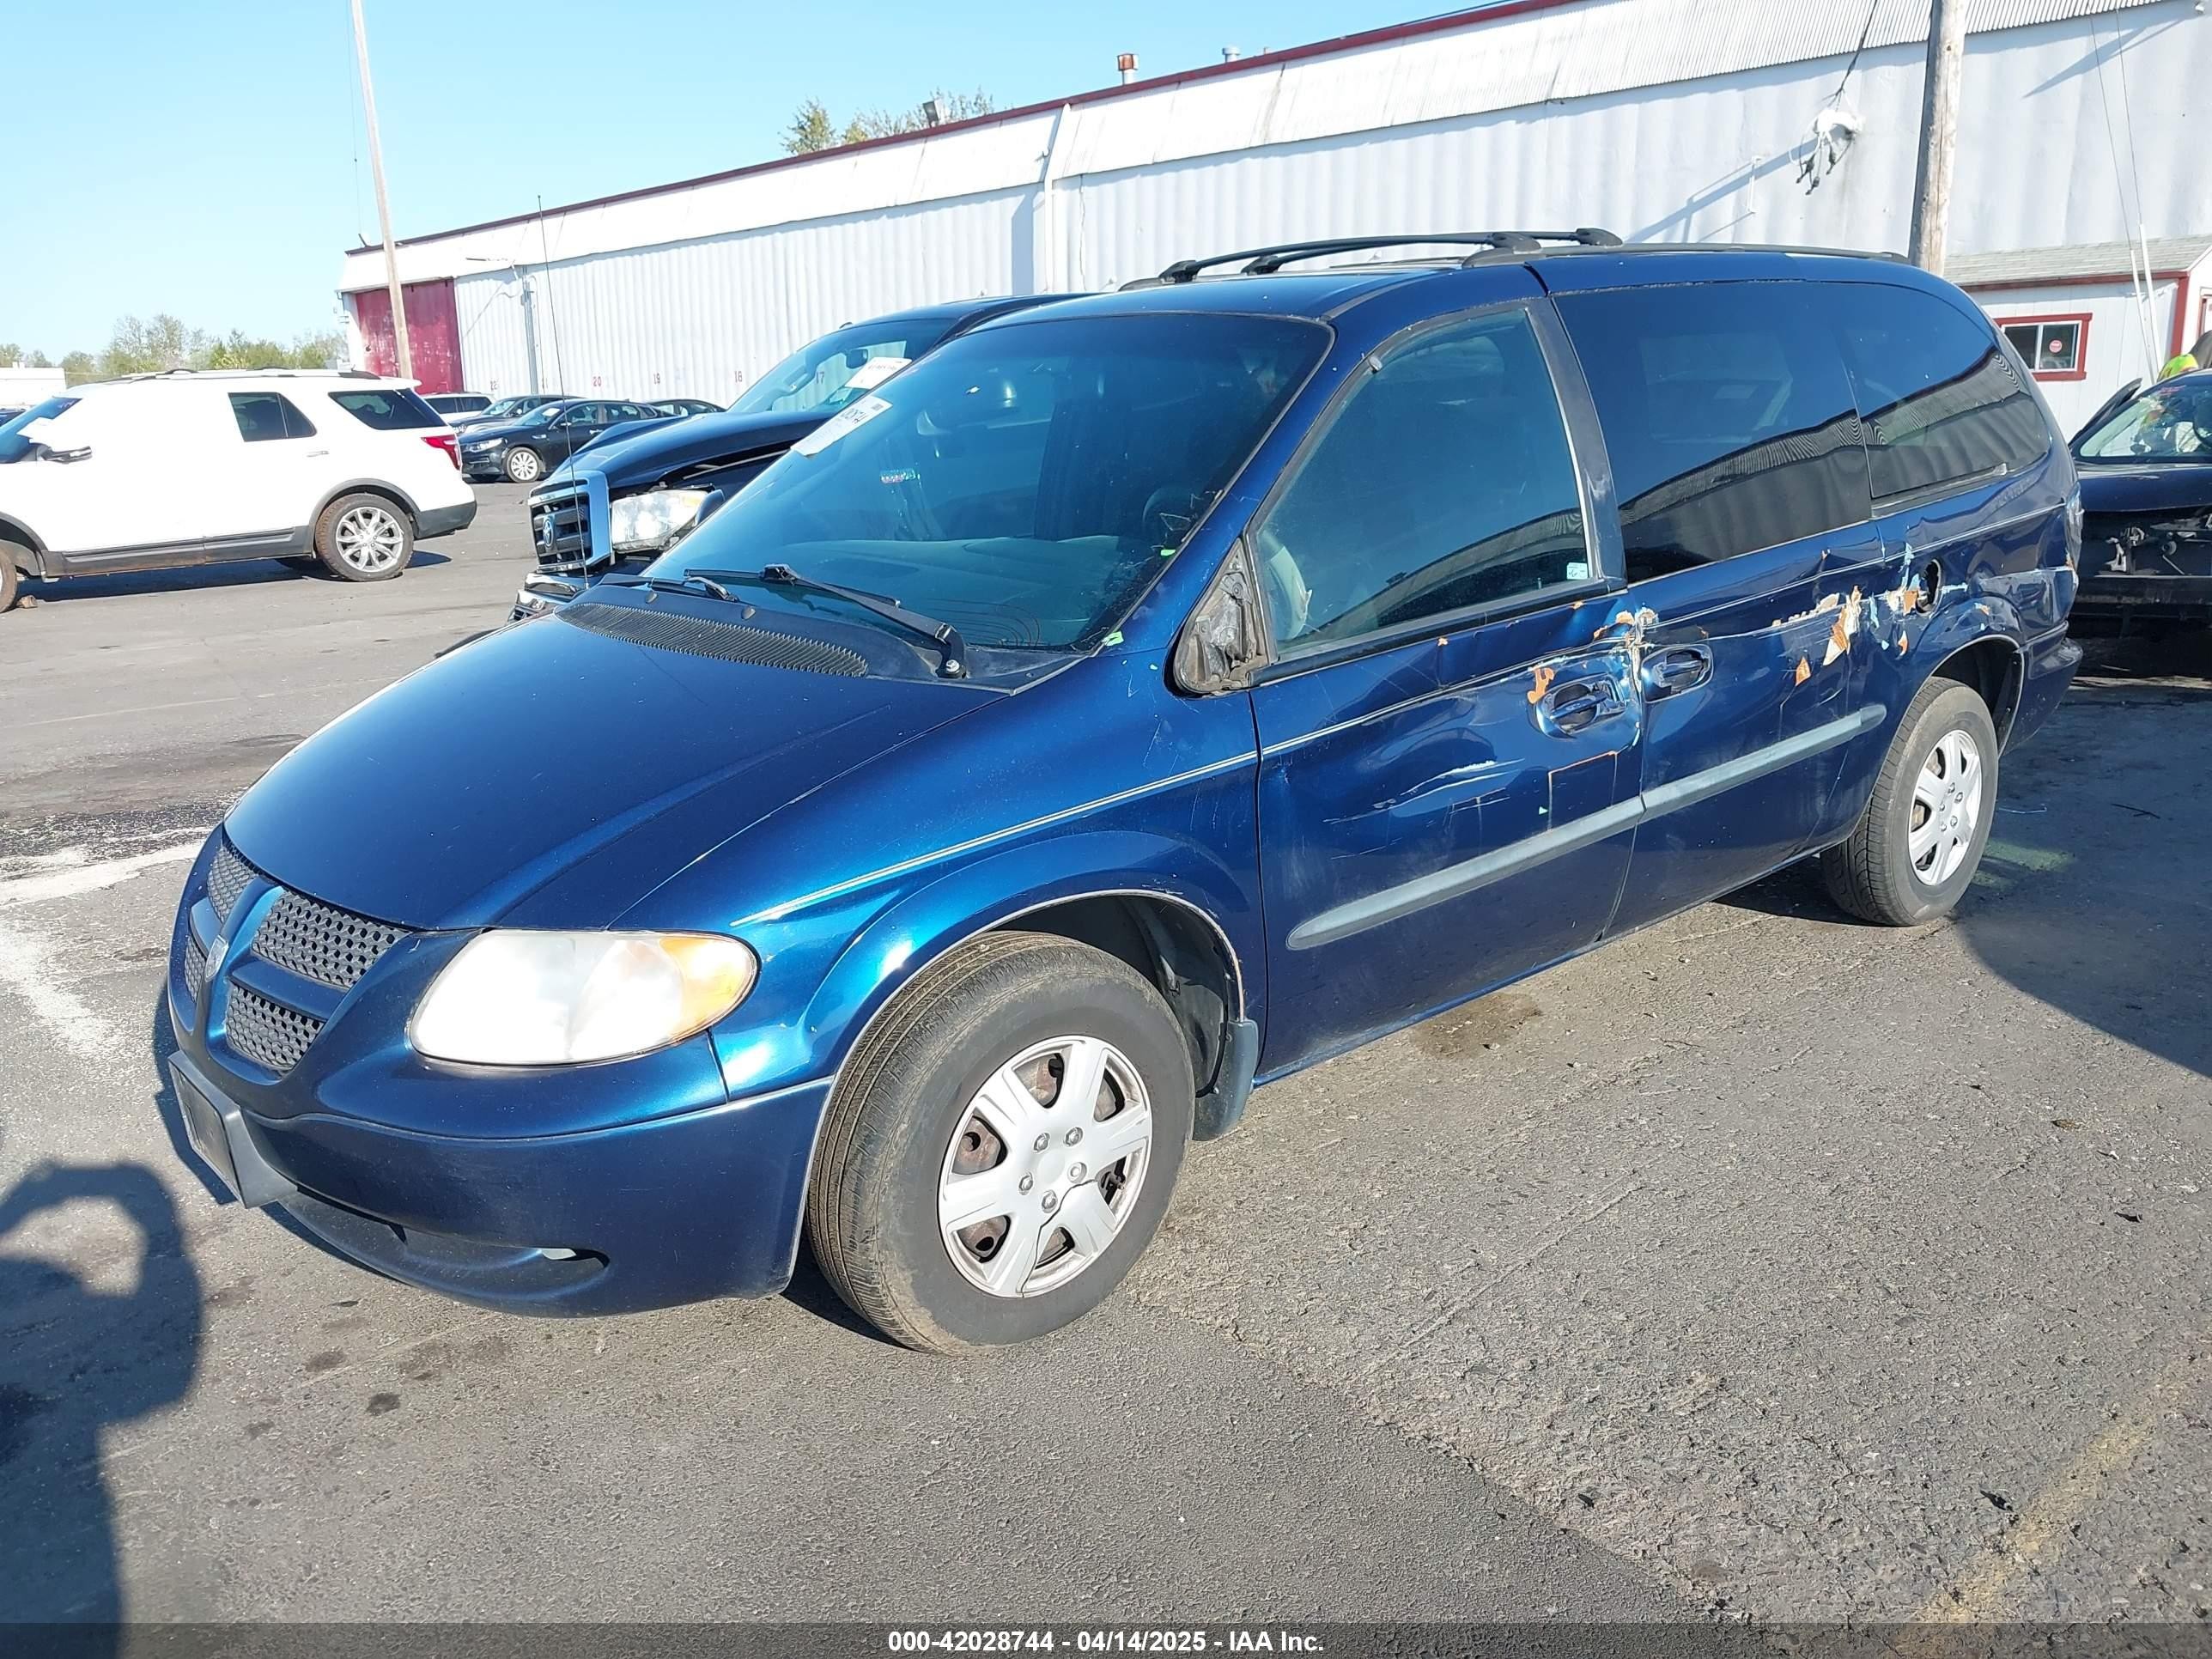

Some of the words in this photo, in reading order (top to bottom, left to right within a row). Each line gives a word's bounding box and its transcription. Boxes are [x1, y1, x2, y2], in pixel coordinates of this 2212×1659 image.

[592, 375, 602, 387] 20
[653, 372, 660, 385] 19
[734, 370, 743, 383] 18
[816, 371, 825, 385] 17
